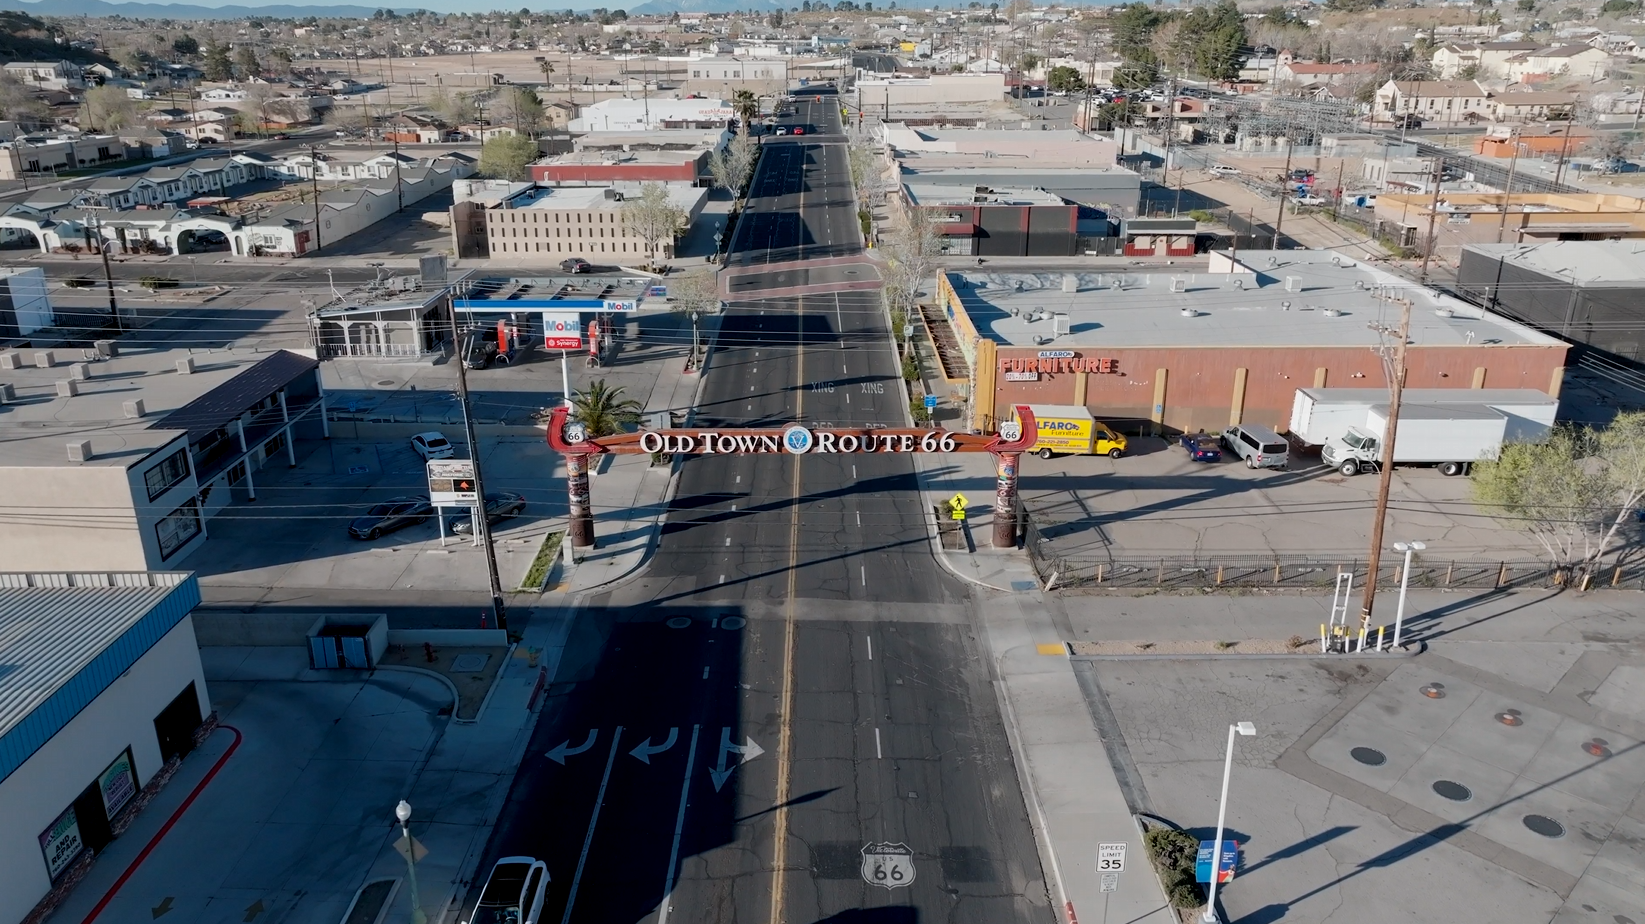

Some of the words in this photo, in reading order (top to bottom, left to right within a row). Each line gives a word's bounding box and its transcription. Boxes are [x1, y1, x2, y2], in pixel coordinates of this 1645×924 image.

[545, 321, 580, 331] Mobil
[1000, 358, 1112, 373] FURNITURE
[811, 381, 835, 393] XING
[861, 383, 884, 394] XING
[1036, 421, 1073, 431] LFARO
[568, 432, 580, 440] 66
[1005, 431, 1017, 439] 66
[639, 432, 695, 453] OLD
[697, 432, 779, 453] TOWN
[816, 432, 913, 453] ROUTE
[921, 431, 956, 453] 66
[55, 834, 70, 852] AND
[51, 834, 78, 866] REPAIR
[1101, 860, 1122, 869] 35
[875, 864, 904, 881] 66
